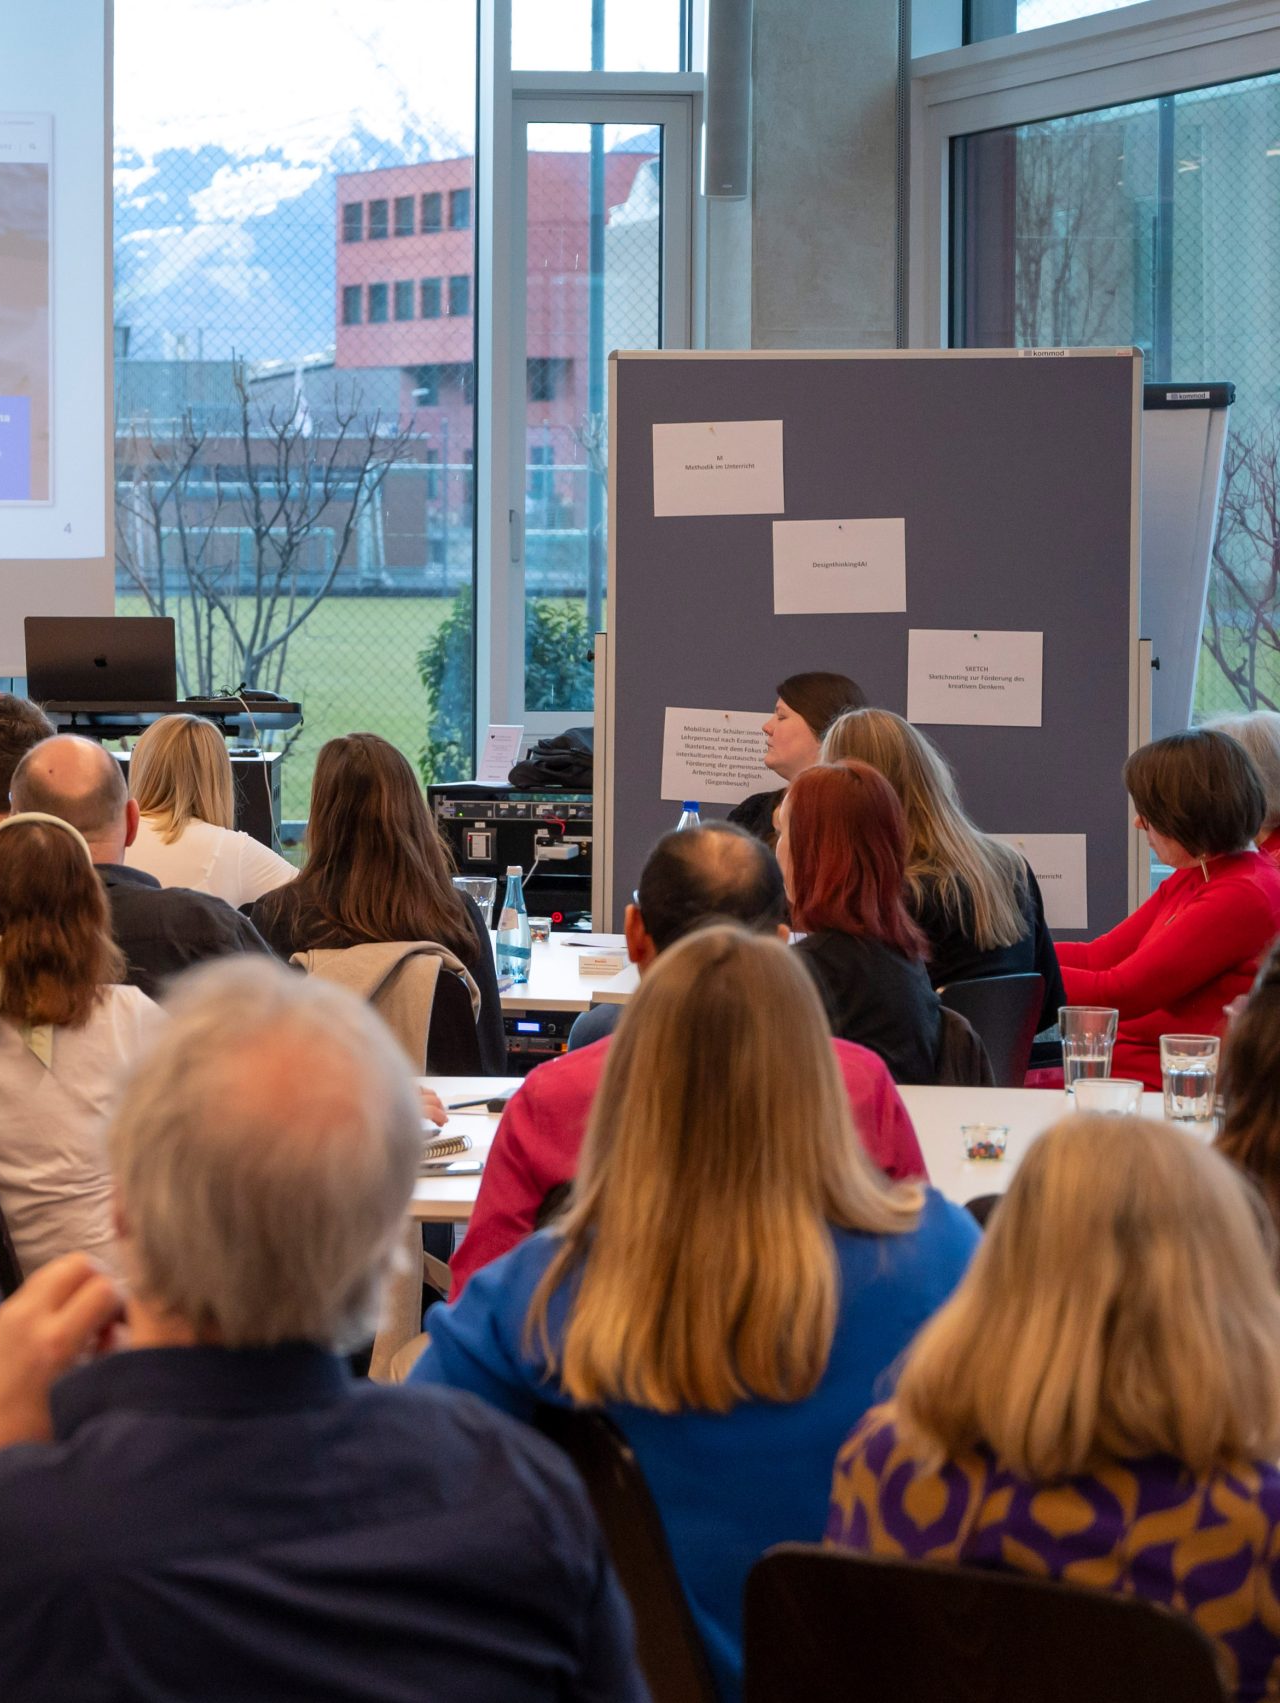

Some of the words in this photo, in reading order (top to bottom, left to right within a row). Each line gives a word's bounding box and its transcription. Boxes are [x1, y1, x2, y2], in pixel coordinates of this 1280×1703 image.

[684, 463, 713, 471] Methodik
[724, 462, 755, 470] Unterricht
[63, 521, 72, 534] 4
[928, 673, 968, 682] Sketchnoting
[978, 683, 1005, 691] Denkens
[680, 734, 720, 743] Lehrpersonal
[675, 752, 723, 760] interkulturellen
[691, 769, 737, 778] Arbeitssprache
